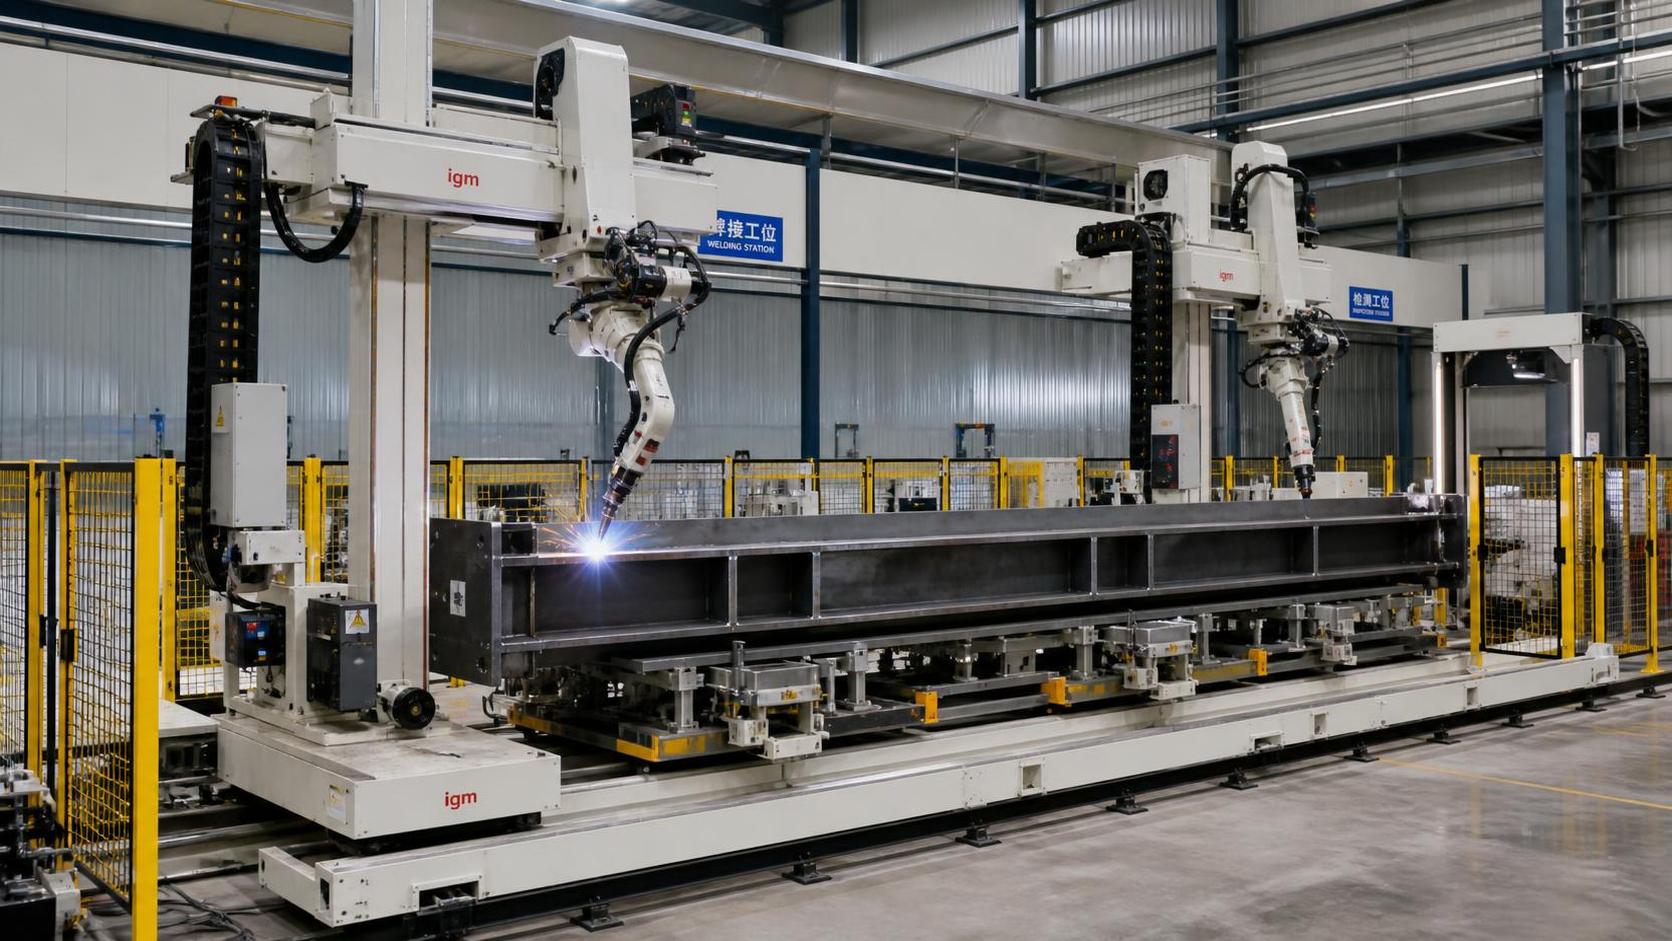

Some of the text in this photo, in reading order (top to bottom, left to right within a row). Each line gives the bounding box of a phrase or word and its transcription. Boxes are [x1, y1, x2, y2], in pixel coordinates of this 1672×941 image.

[448, 168, 479, 188] igm
[707, 240, 775, 254] WELDING STATION
[445, 791, 477, 810] igm
